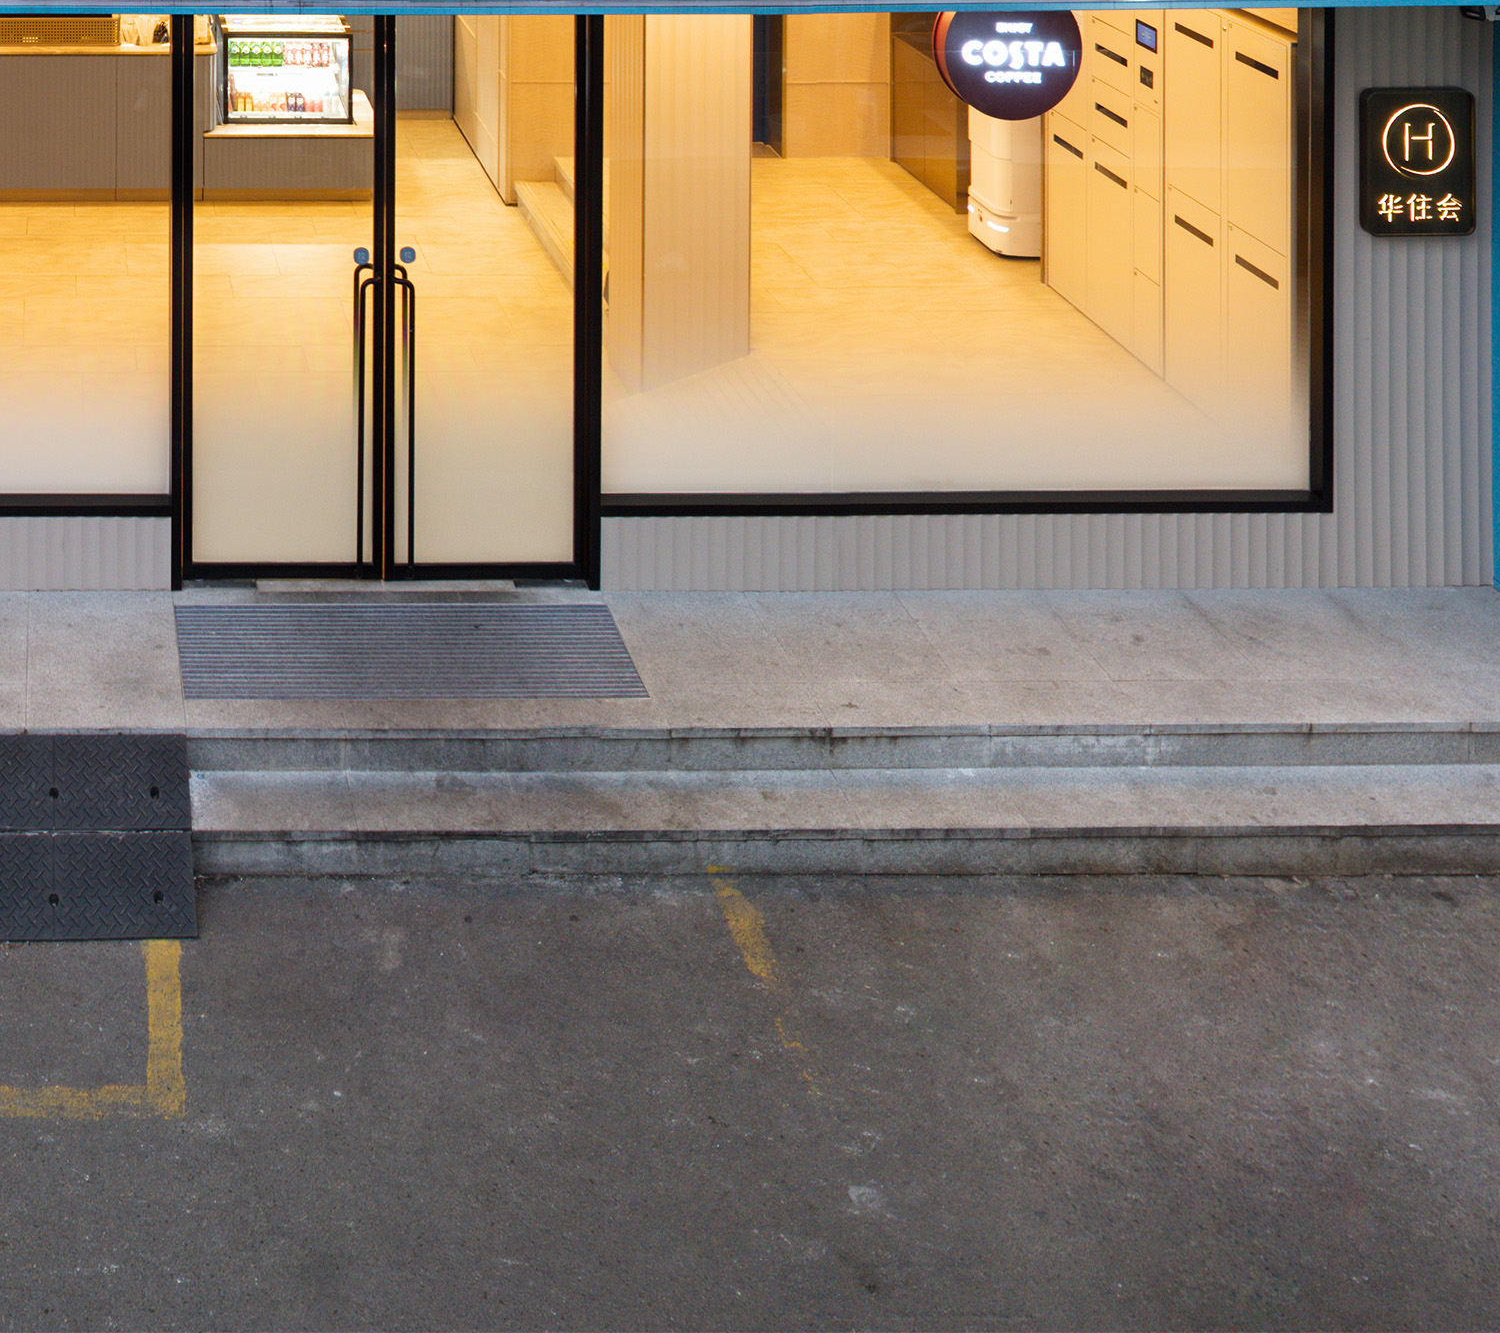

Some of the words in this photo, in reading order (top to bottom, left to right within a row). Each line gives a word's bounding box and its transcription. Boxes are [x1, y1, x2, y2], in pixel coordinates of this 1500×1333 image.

[961, 40, 1066, 70] COSTA
[984, 71, 1042, 84] COFFEE
[1404, 122, 1436, 162] H
[1378, 193, 1463, 223] 华住会
